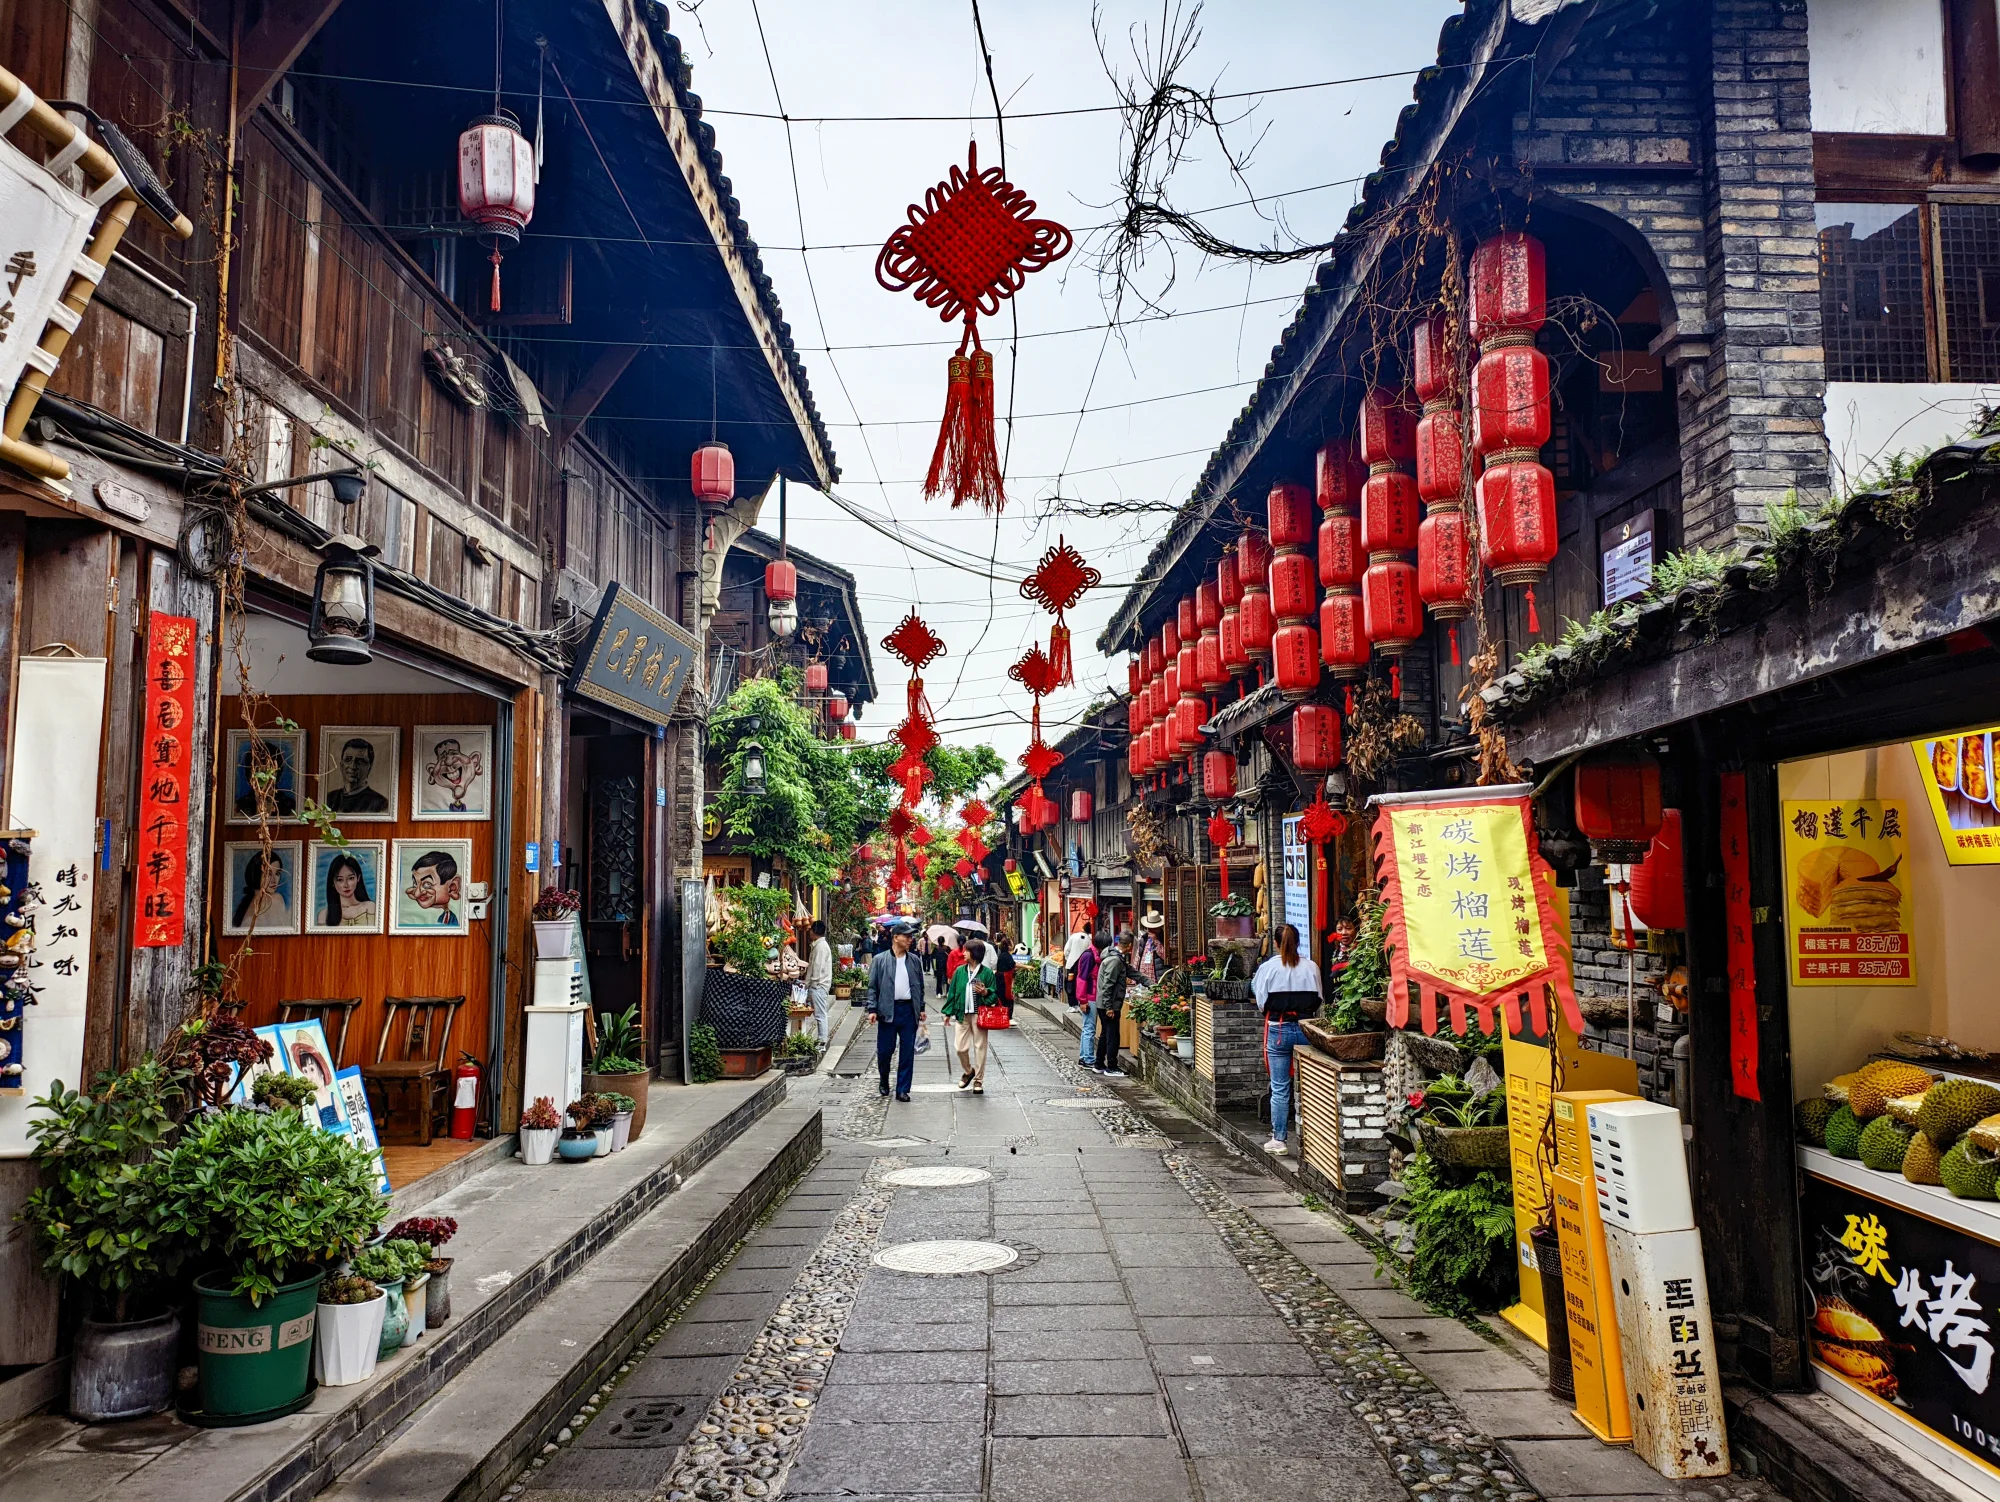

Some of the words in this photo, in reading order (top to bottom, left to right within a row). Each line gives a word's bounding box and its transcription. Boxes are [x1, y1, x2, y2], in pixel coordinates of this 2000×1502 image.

[1407, 823, 1432, 898] 都江堰之恋
[1440, 819, 1498, 962] 碳烤榴莲
[46, 863, 82, 976] 時光知味
[1508, 876, 1535, 958] 现烤榴莲
[1805, 938, 1850, 950] 榴莲千层
[1857, 936, 1900, 952] 28元/份
[1806, 962, 1850, 974] 芒果千层
[1858, 960, 1902, 975] 25元/份
[1663, 1278, 1705, 1379] 充电宝
[1841, 1213, 1995, 1395] 碳烤
[1676, 1383, 1707, 1396] 免押金
[1679, 1398, 1709, 1417] 使用
[1681, 1414, 1713, 1434] 扫码
